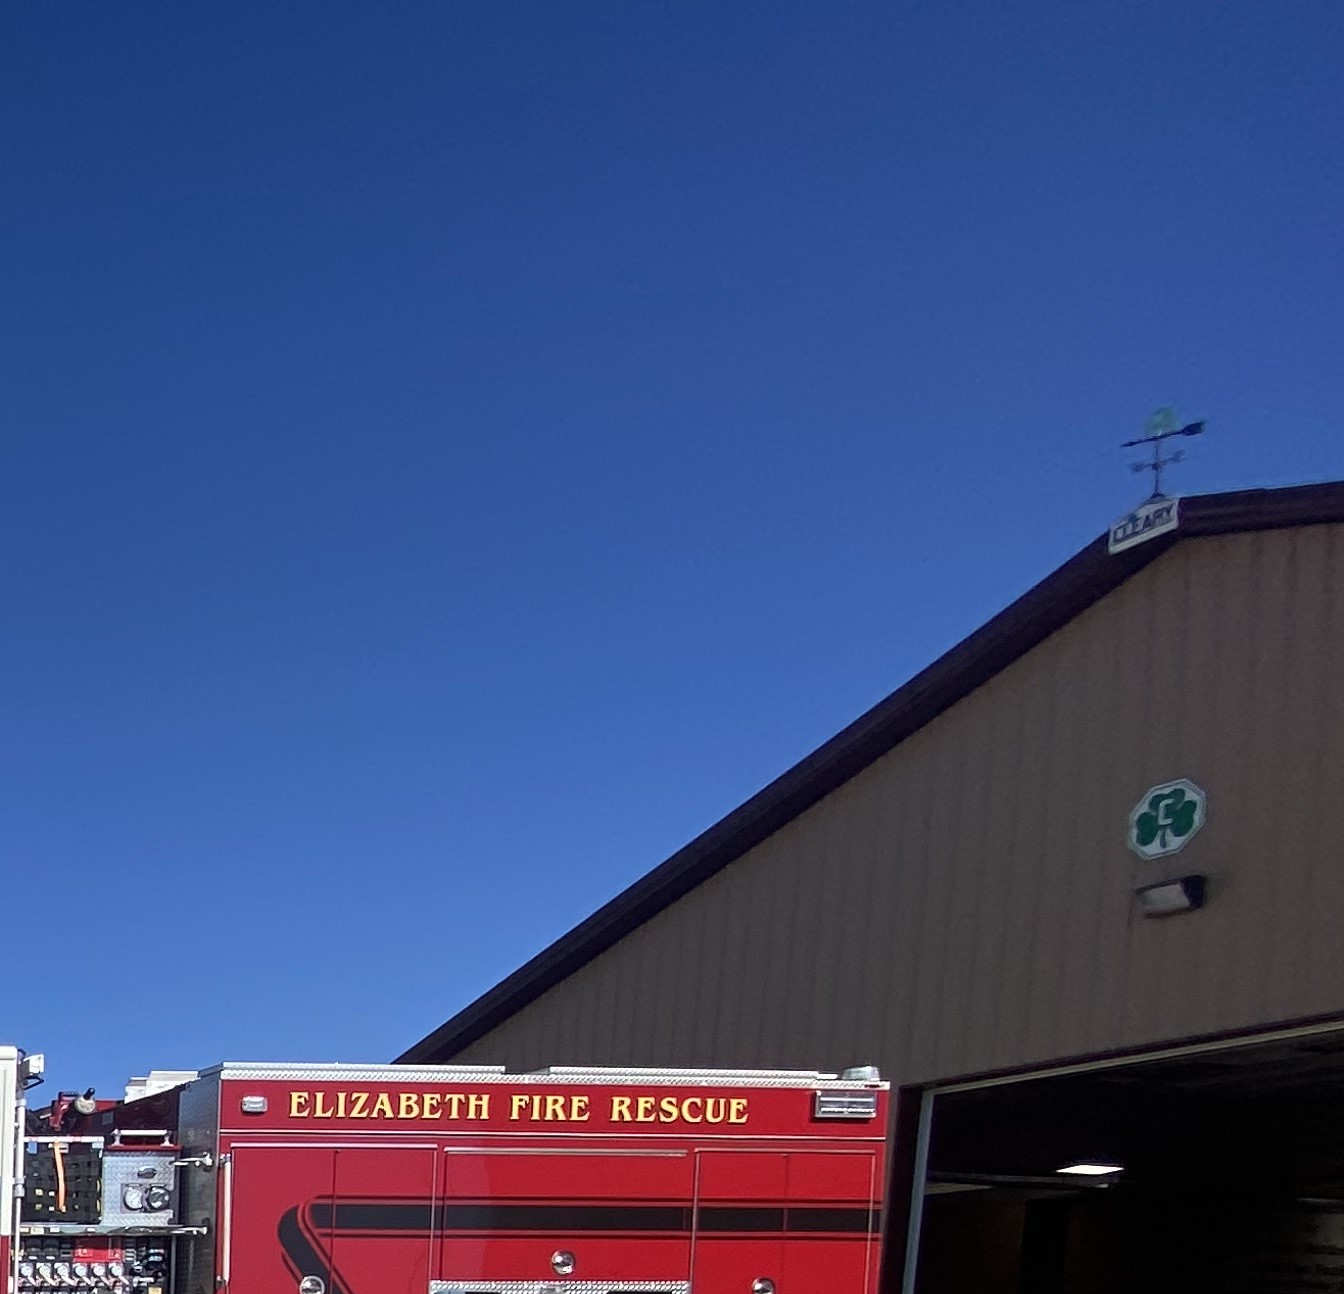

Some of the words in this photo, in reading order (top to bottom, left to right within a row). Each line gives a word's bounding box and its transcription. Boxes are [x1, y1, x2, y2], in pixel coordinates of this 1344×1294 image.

[289, 1090, 491, 1121] ELIZABETH
[510, 1094, 590, 1122] FIRE
[610, 1096, 750, 1124] RESCUE
